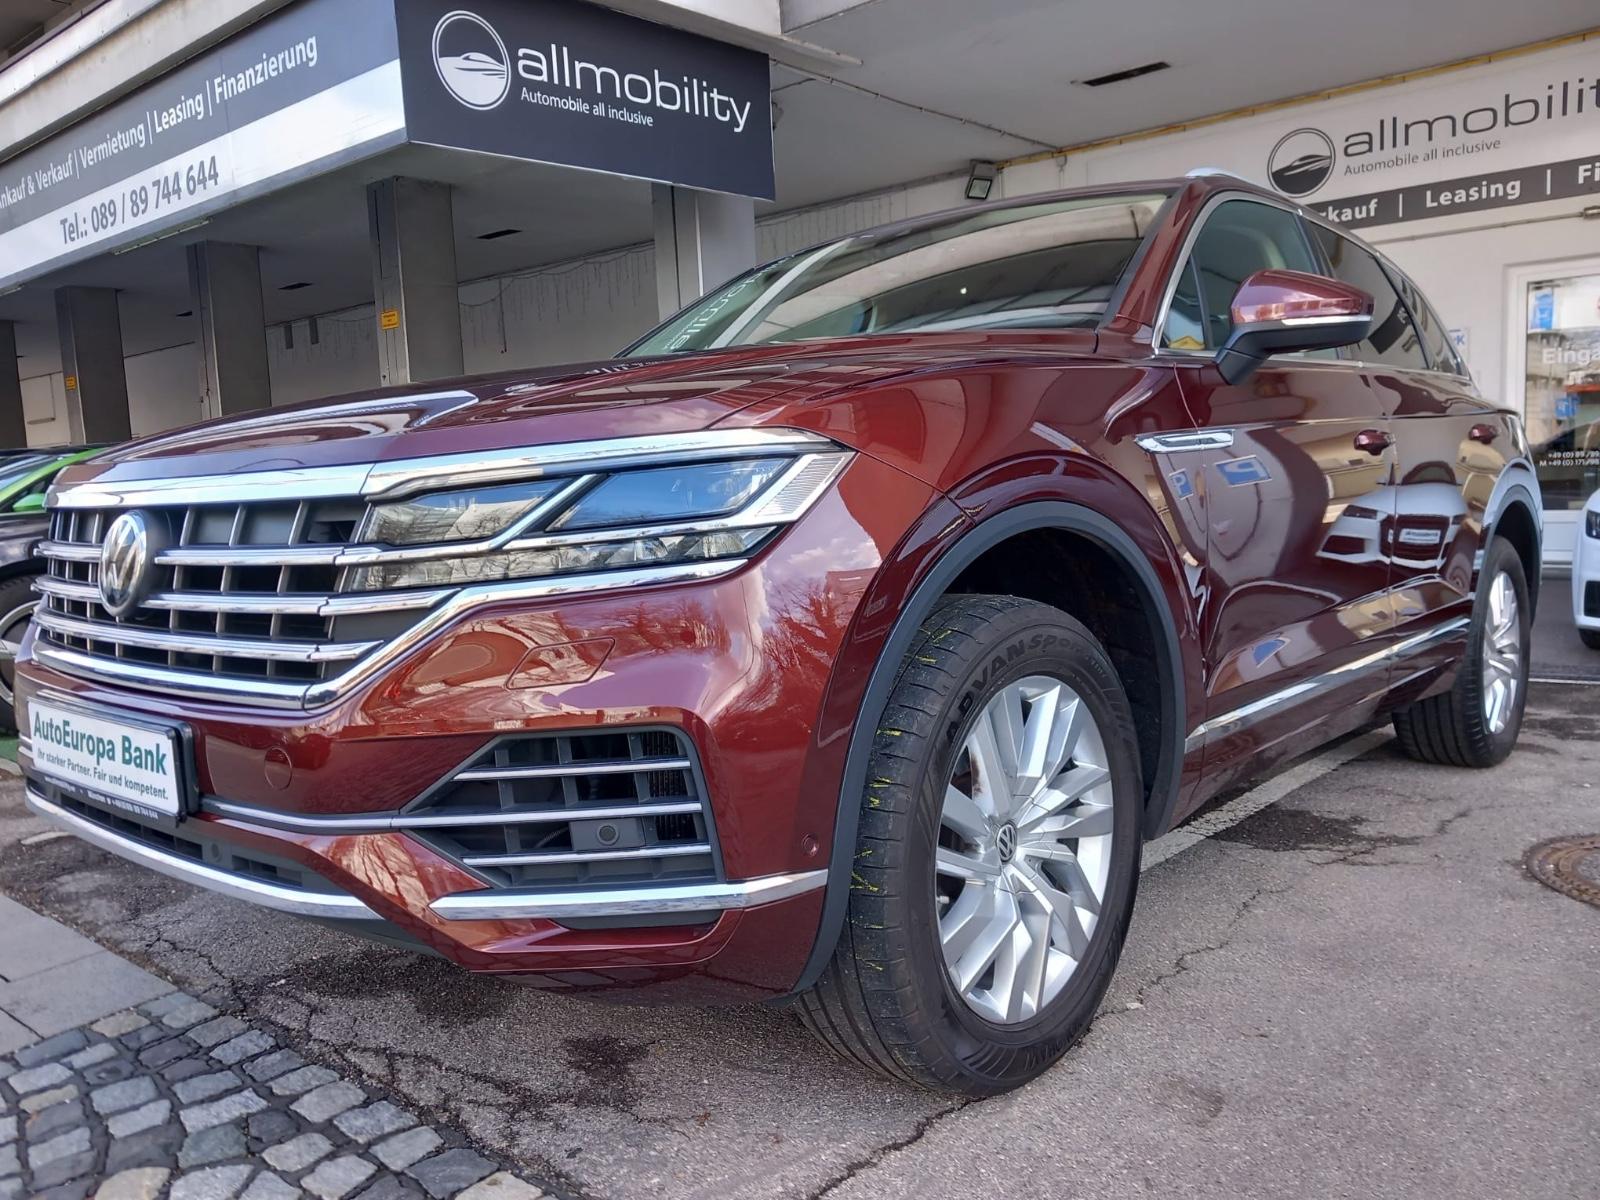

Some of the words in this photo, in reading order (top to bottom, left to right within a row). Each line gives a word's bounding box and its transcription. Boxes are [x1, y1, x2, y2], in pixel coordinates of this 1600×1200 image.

[35, 153, 73, 191] Verkauf
[79, 122, 146, 169] Vermietung
[153, 91, 205, 134] Leasing
[214, 36, 318, 104] Finanzierung
[517, 43, 751, 132] allmobility
[520, 87, 590, 114] Automobile
[592, 101, 605, 118] all
[607, 105, 654, 127] inclusive
[1343, 151, 1419, 176] Automobile
[1423, 147, 1438, 162] all
[1442, 139, 1501, 158] inclusive
[60, 211, 88, 245] Tel.:
[91, 199, 117, 233] 089
[129, 185, 149, 218] 89
[151, 171, 182, 210] 744
[185, 155, 219, 196] 644
[1320, 198, 1378, 222] kauf
[1425, 178, 1522, 208] Leasing
[33, 711, 116, 766] AutoEuropa
[121, 735, 168, 776] Bank
[67, 760, 92, 777] Partner.
[93, 766, 107, 782] Fair
[109, 773, 123, 787] und
[124, 776, 169, 800] kompetent.
